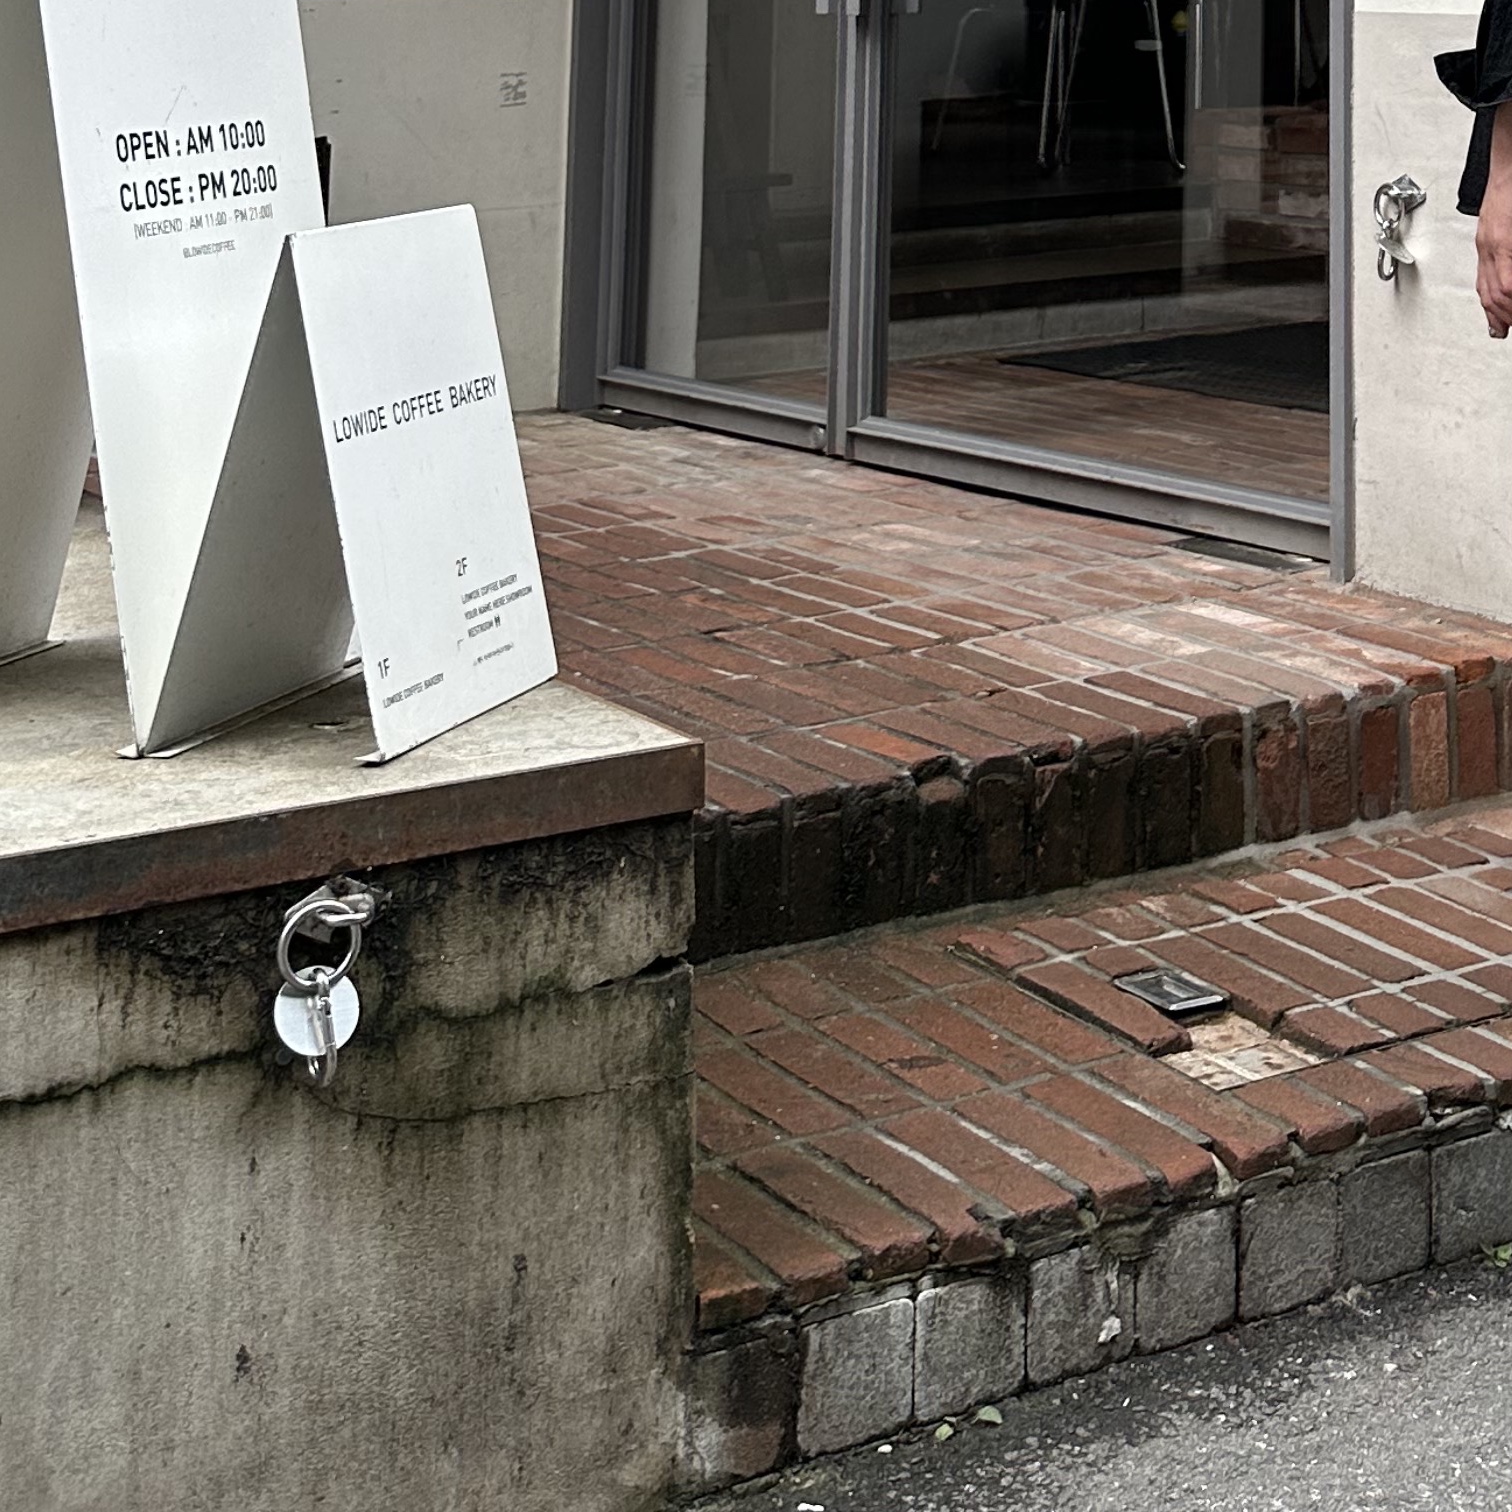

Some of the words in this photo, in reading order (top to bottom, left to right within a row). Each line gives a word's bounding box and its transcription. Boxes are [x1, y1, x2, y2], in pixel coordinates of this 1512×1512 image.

[116, 129, 170, 162] OPEN
[187, 125, 214, 155] AM
[219, 120, 266, 151] 10:00
[120, 176, 183, 212] CLOSE
[198, 170, 227, 201] PM
[230, 165, 277, 197] 20:00
[333, 406, 388, 443] LOWIDE
[392, 390, 444, 425] COFFEE
[449, 374, 497, 408] BAKERY
[456, 557, 467, 577] 2F
[378, 657, 390, 680] 1F
